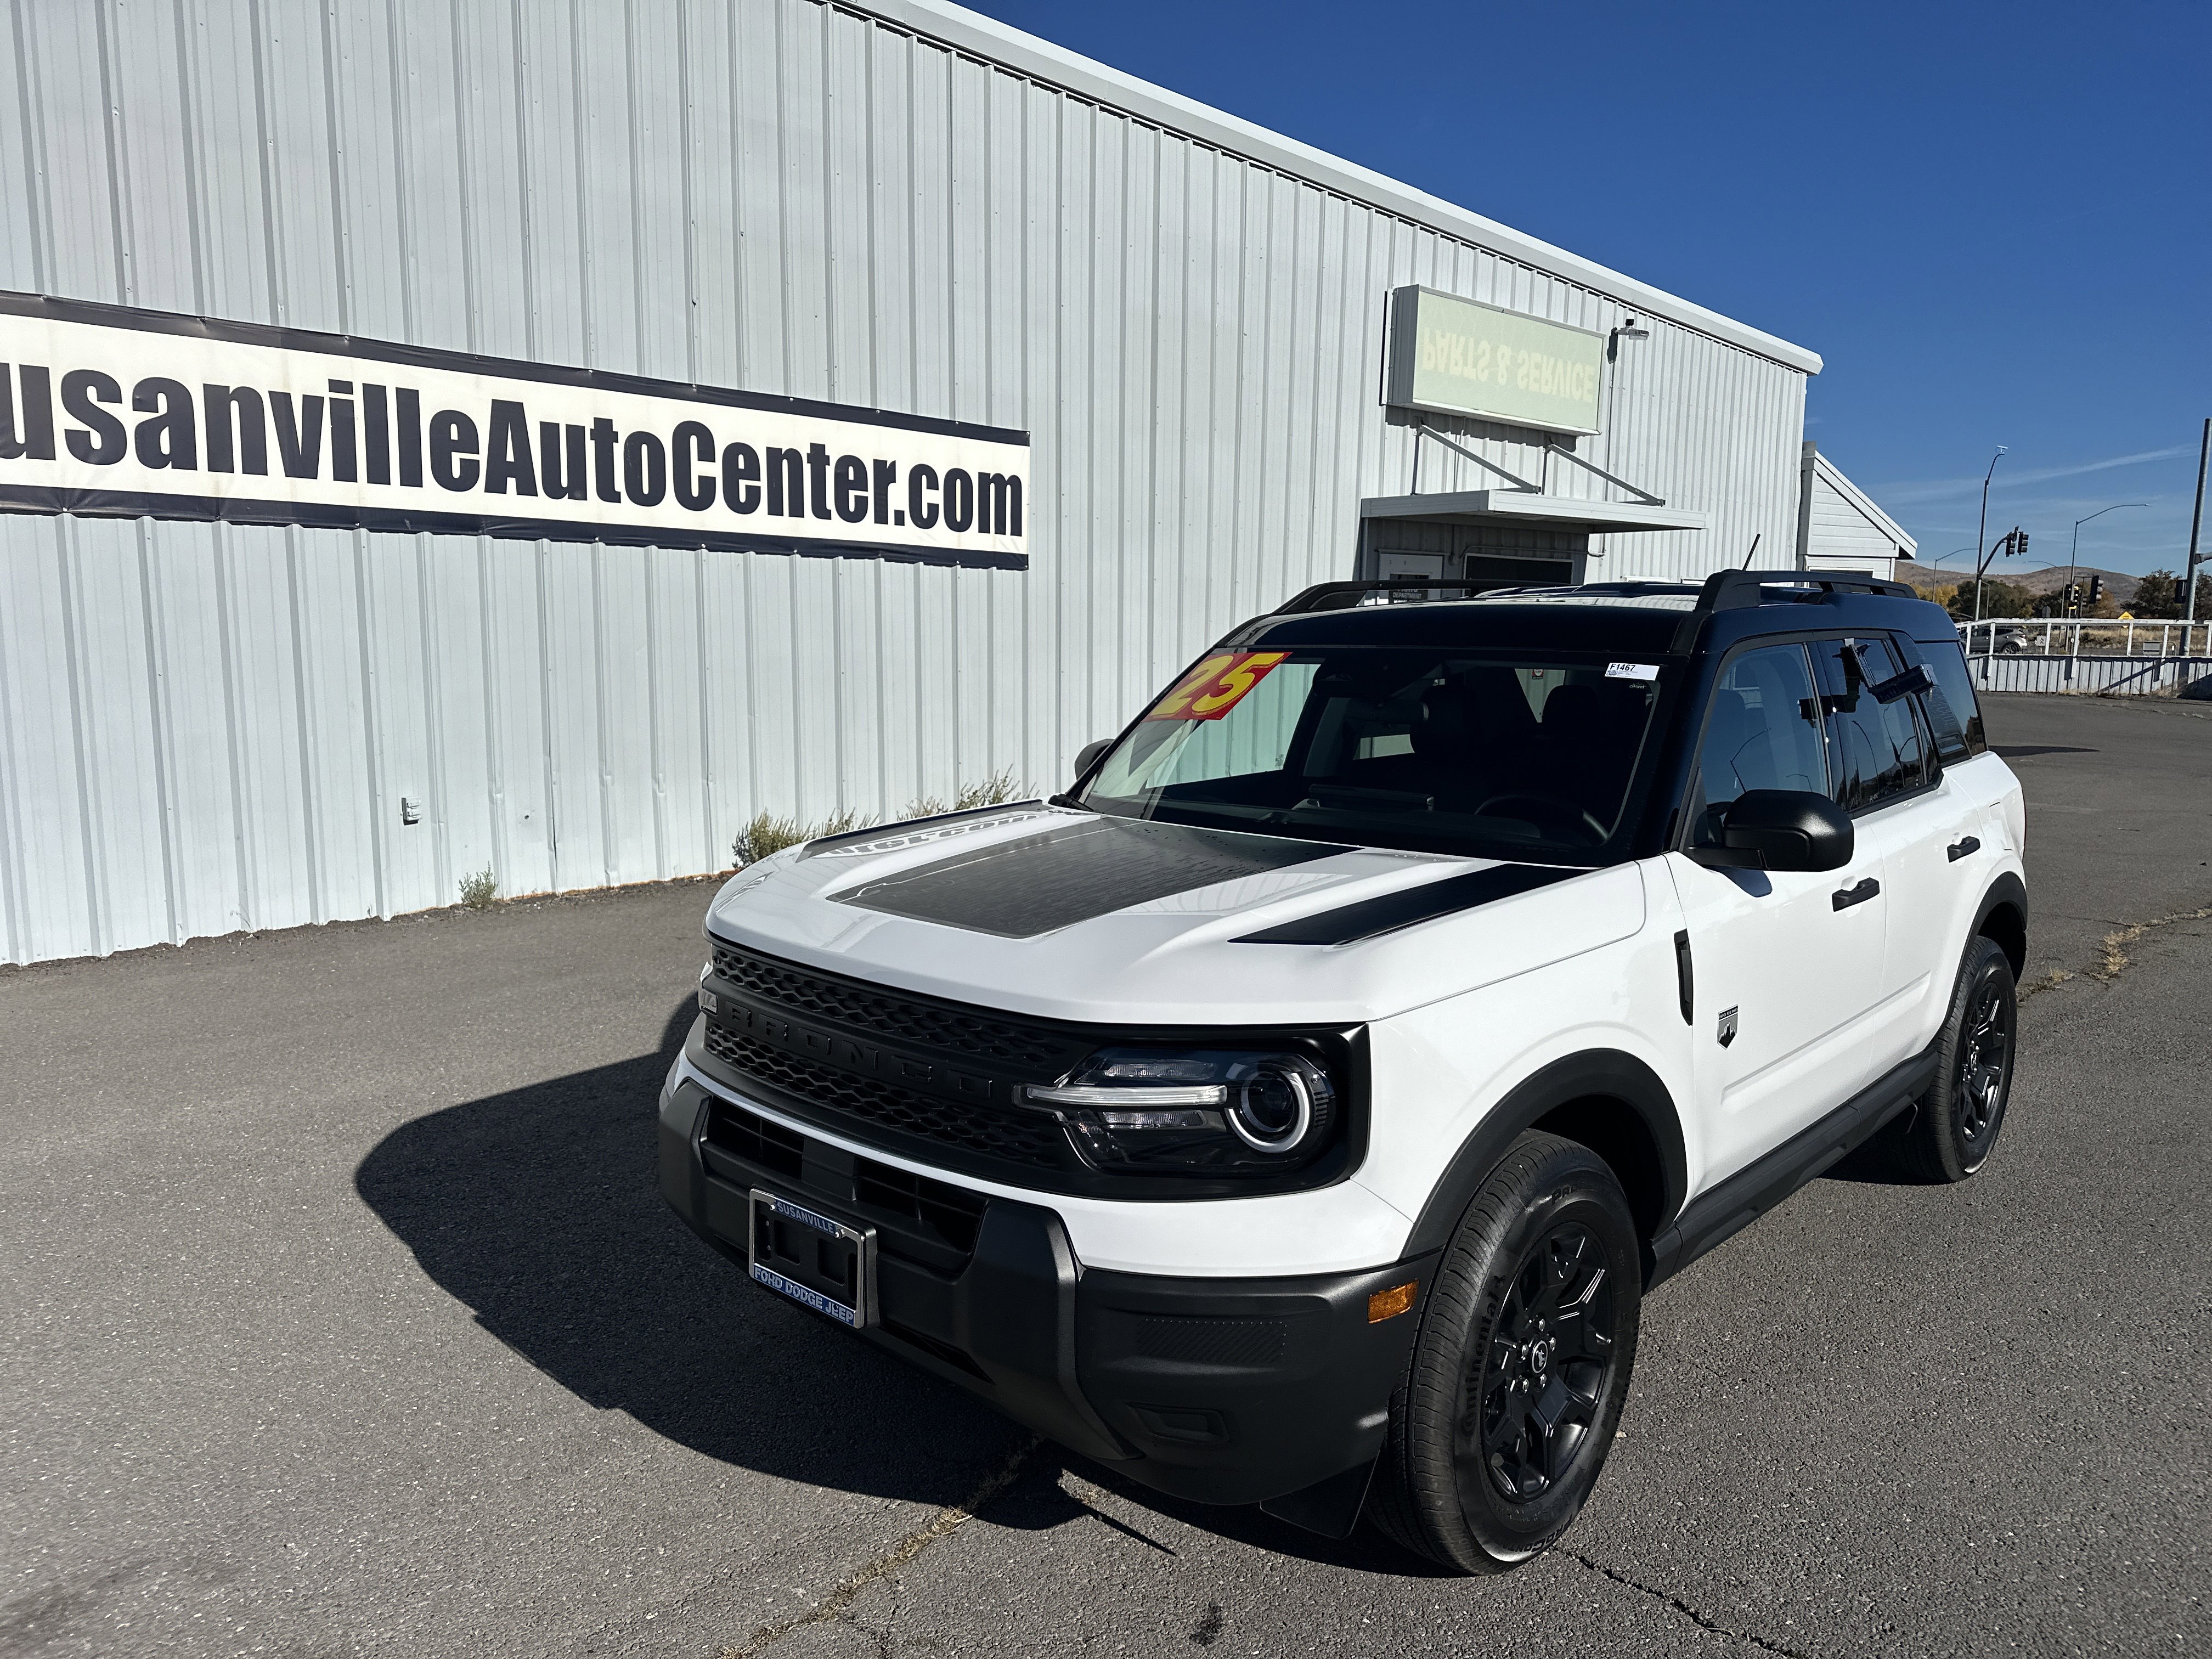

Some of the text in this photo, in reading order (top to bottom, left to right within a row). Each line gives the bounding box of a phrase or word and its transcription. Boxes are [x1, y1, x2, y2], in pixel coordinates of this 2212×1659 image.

[1150, 653, 1285, 716] 25
[1610, 663, 1636, 672] F1467
[725, 1001, 993, 1099] BRONCO
[776, 1202, 834, 1234] SUSANVILLE
[754, 1267, 854, 1323] FORD DODGE JEEP
